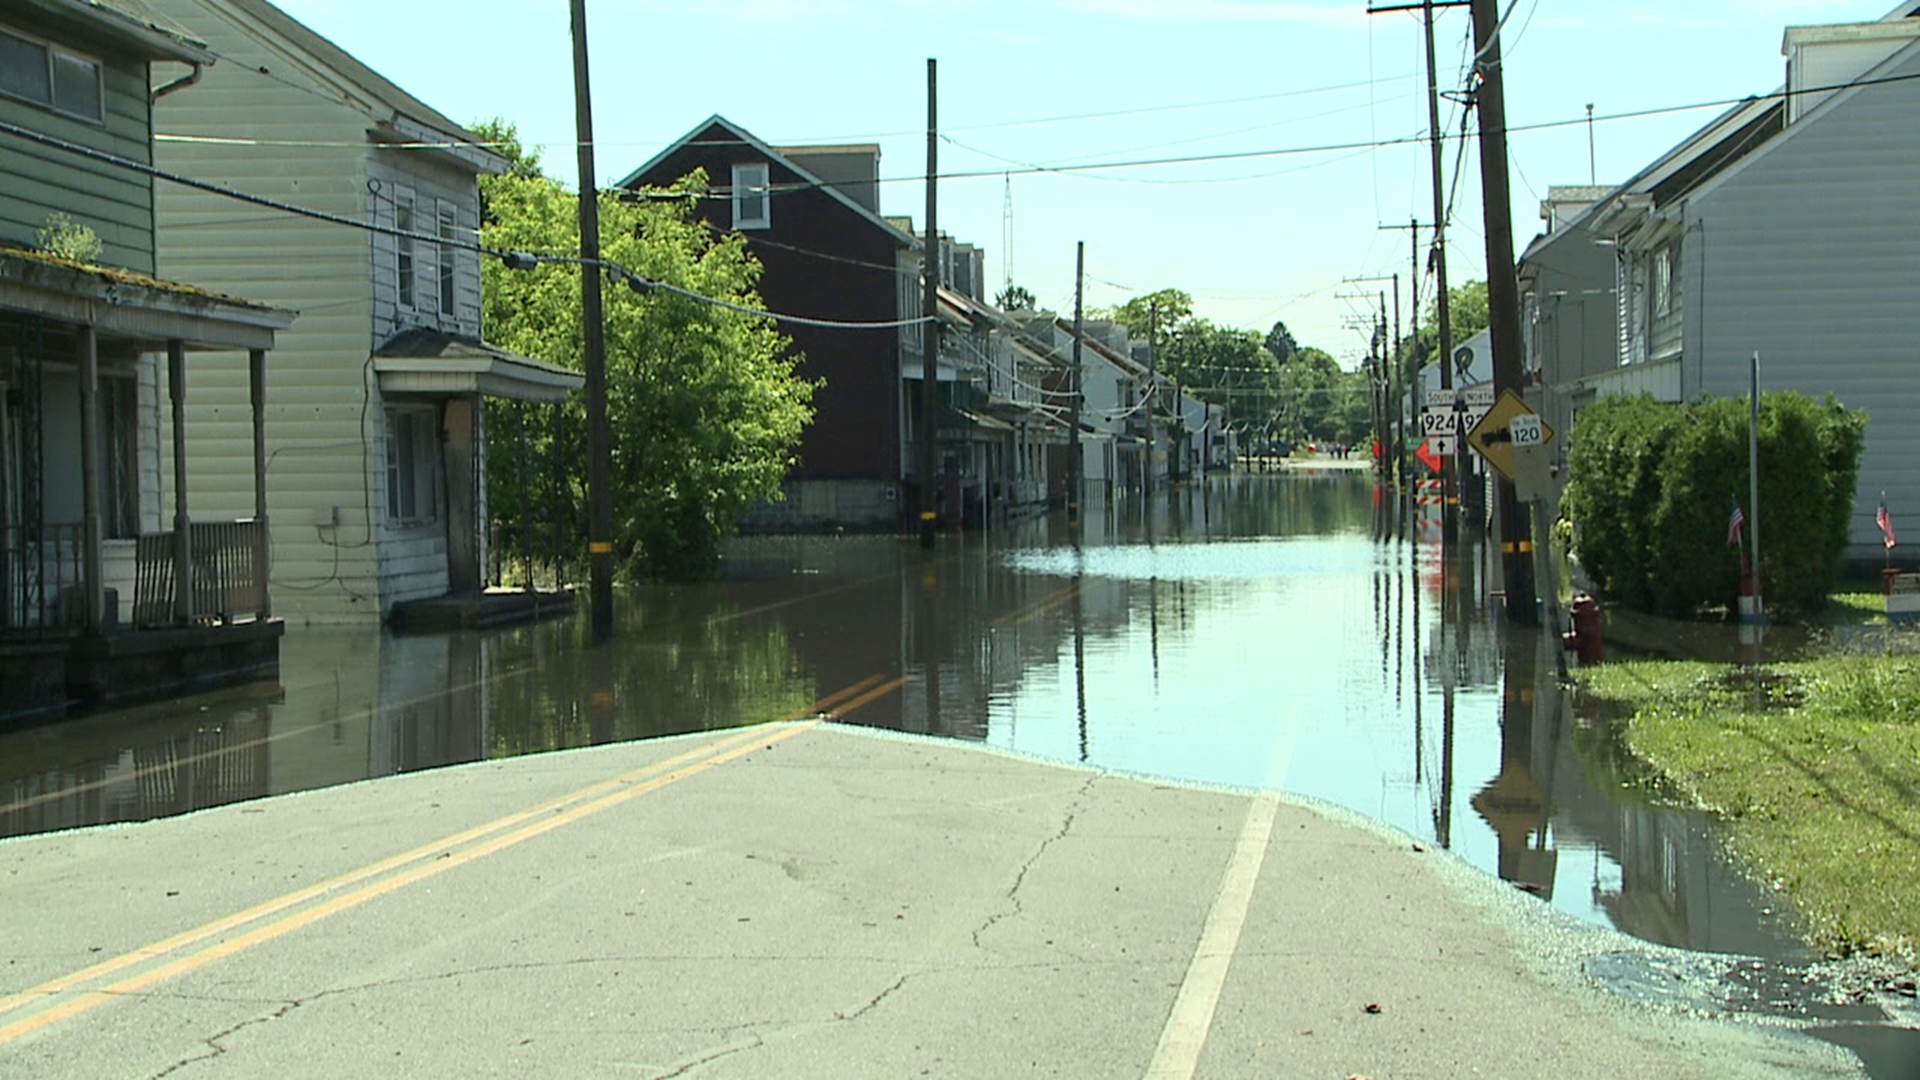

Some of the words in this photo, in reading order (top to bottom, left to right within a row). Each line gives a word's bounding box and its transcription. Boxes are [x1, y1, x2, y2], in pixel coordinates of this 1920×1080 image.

[1427, 391, 1454, 403] SOUTH
[1466, 392, 1493, 403] NORTH
[1425, 413, 1456, 431] 924
[1514, 426, 1540, 443] 120
